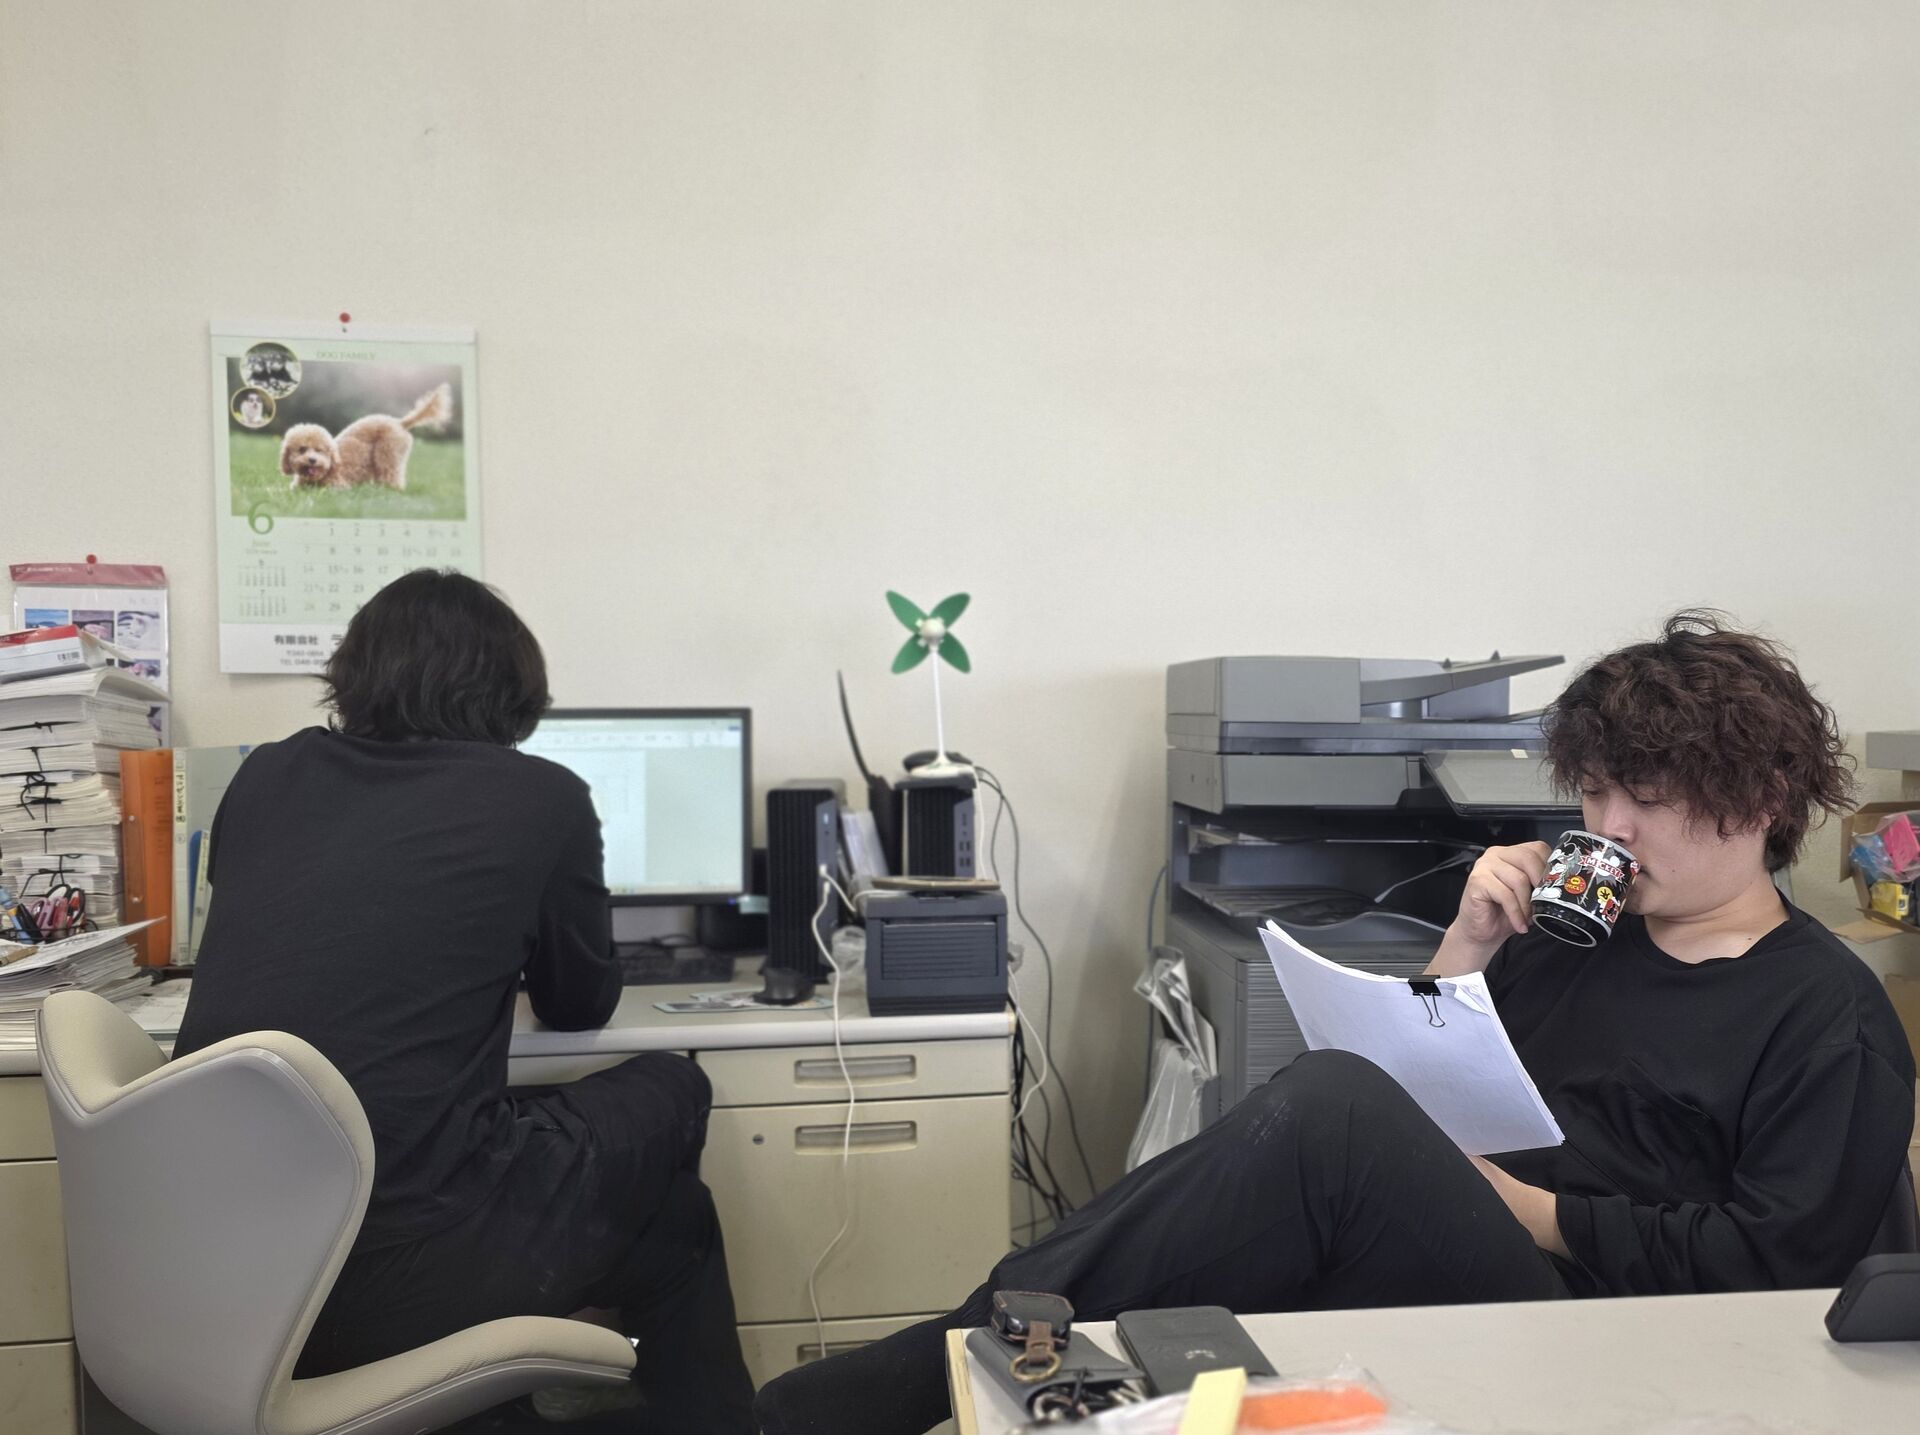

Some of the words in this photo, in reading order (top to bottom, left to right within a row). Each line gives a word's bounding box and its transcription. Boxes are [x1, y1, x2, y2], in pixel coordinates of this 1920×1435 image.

[316, 351, 338, 360] DOG
[340, 351, 377, 361] FAMILY
[248, 500, 275, 535] 6
[354, 527, 361, 537] 2
[380, 528, 386, 537] 3
[329, 546, 336, 555] 8
[377, 546, 389, 556] 10
[303, 565, 314, 574] 14
[329, 565, 339, 575] 15
[353, 565, 364, 574] 16
[378, 565, 389, 574] 17
[329, 584, 340, 593] 22
[353, 584, 364, 594] 23
[329, 602, 341, 612] 29
[274, 634, 319, 646] 有限会社
[1586, 858, 1620, 877] MICKEY
